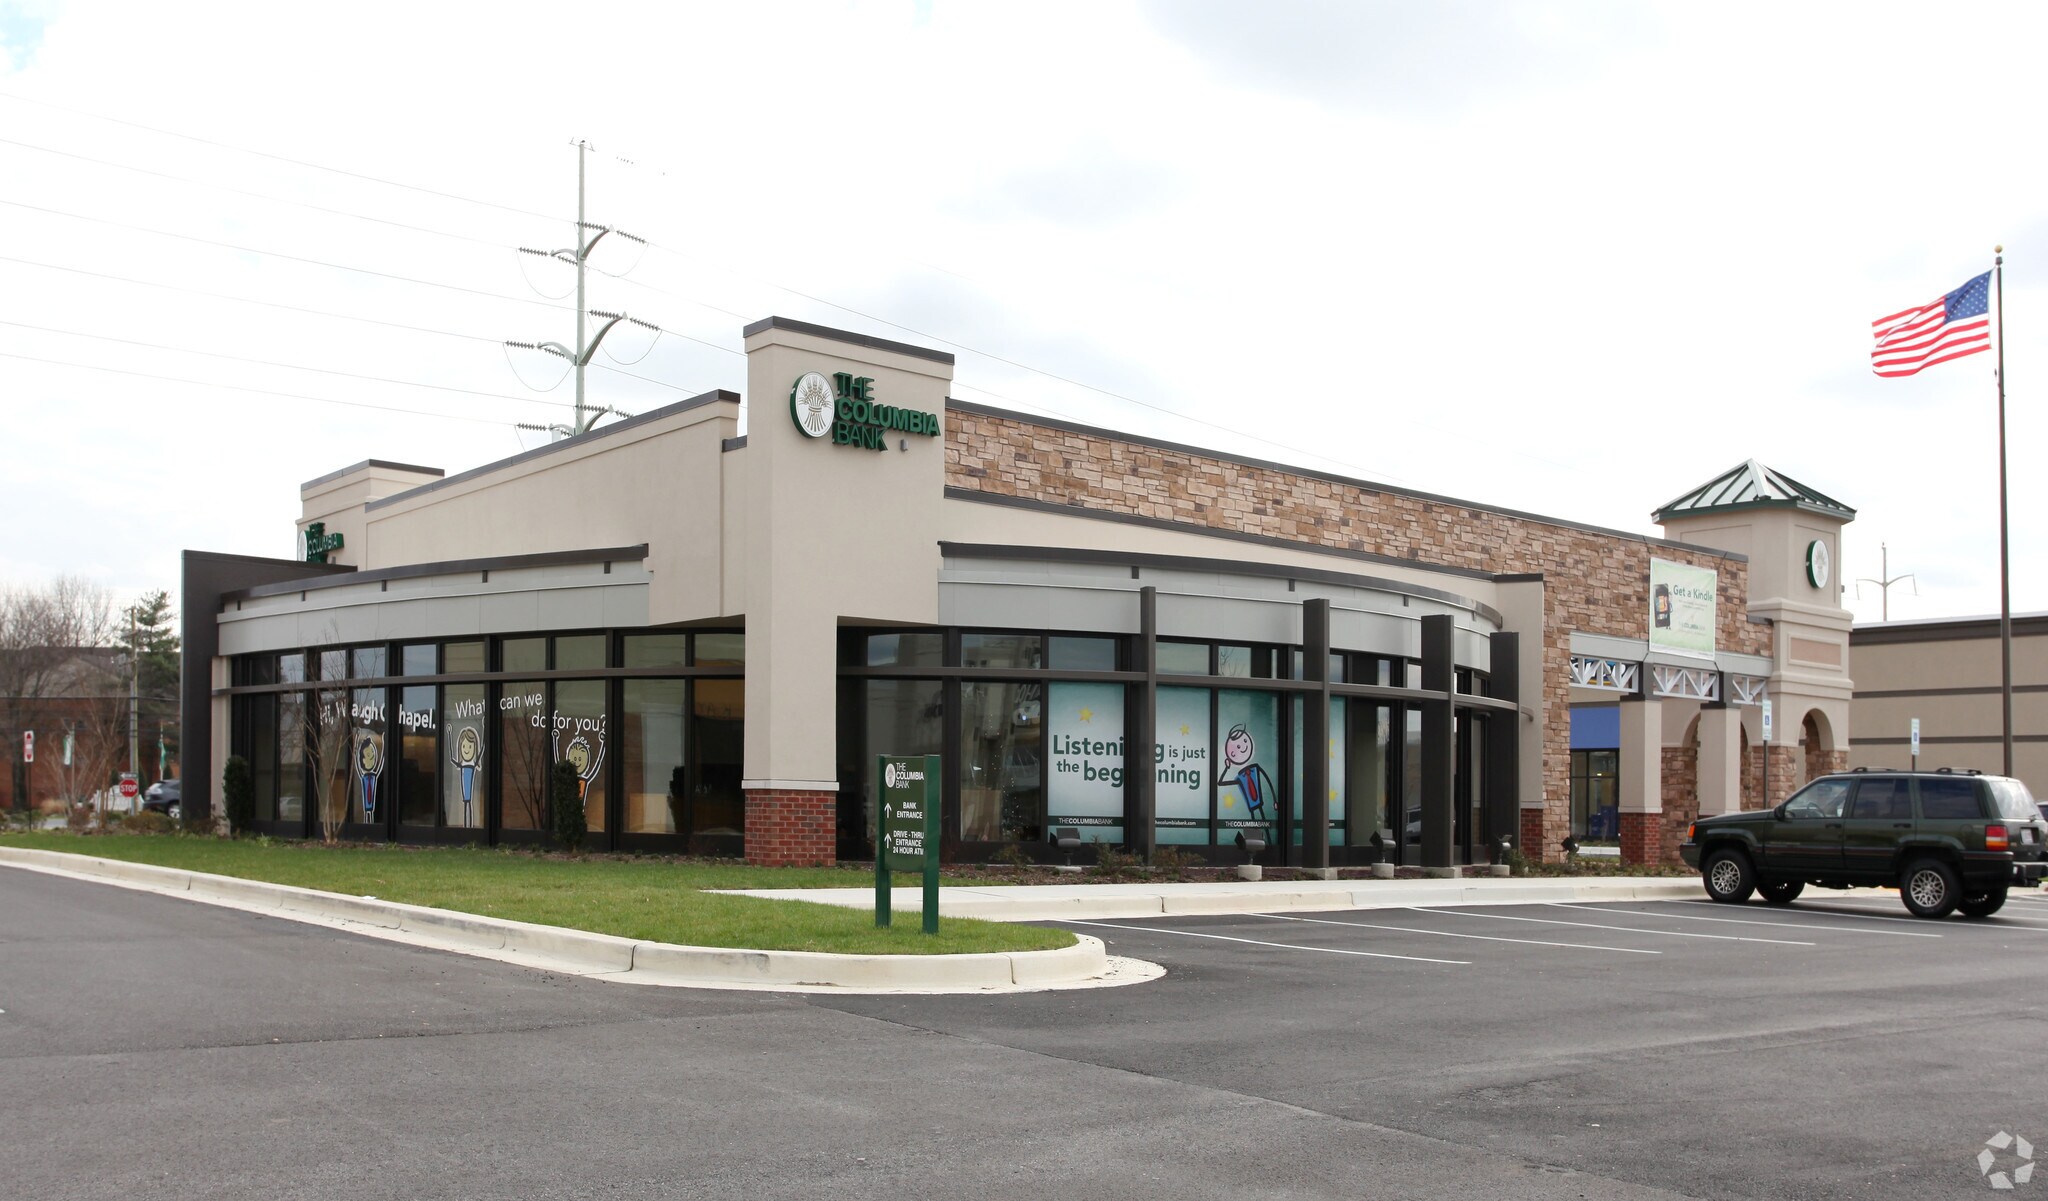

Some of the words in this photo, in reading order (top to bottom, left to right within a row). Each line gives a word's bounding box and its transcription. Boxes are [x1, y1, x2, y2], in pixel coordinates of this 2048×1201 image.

[833, 372, 874, 400] THE
[835, 397, 941, 436] COLUMBIA
[832, 421, 888, 451] BANK
[1673, 585, 1686, 597] Get
[1687, 590, 1692, 598] a
[1693, 589, 1713, 602] Kindle
[500, 695, 520, 710] can
[524, 693, 542, 707] we
[552, 710, 571, 729] for
[575, 714, 606, 735] you?
[1053, 735, 1165, 763] Listenig
[1169, 745, 1179, 758] is
[1182, 745, 1206, 762] just
[896, 762, 906, 771] THE
[896, 771, 925, 780] COLUMBIA
[1057, 759, 1080, 772] the
[1083, 760, 1201, 790] begning
[120, 784, 137, 792] STOP
[895, 780, 910, 789] BANK
[902, 801, 917, 809] BANK
[896, 810, 923, 819] ENTRANCE
[893, 830, 908, 838] DRIVE
[911, 831, 925, 839] THRU
[895, 838, 922, 847] ENTRANCE
[899, 847, 914, 855] HOUR
